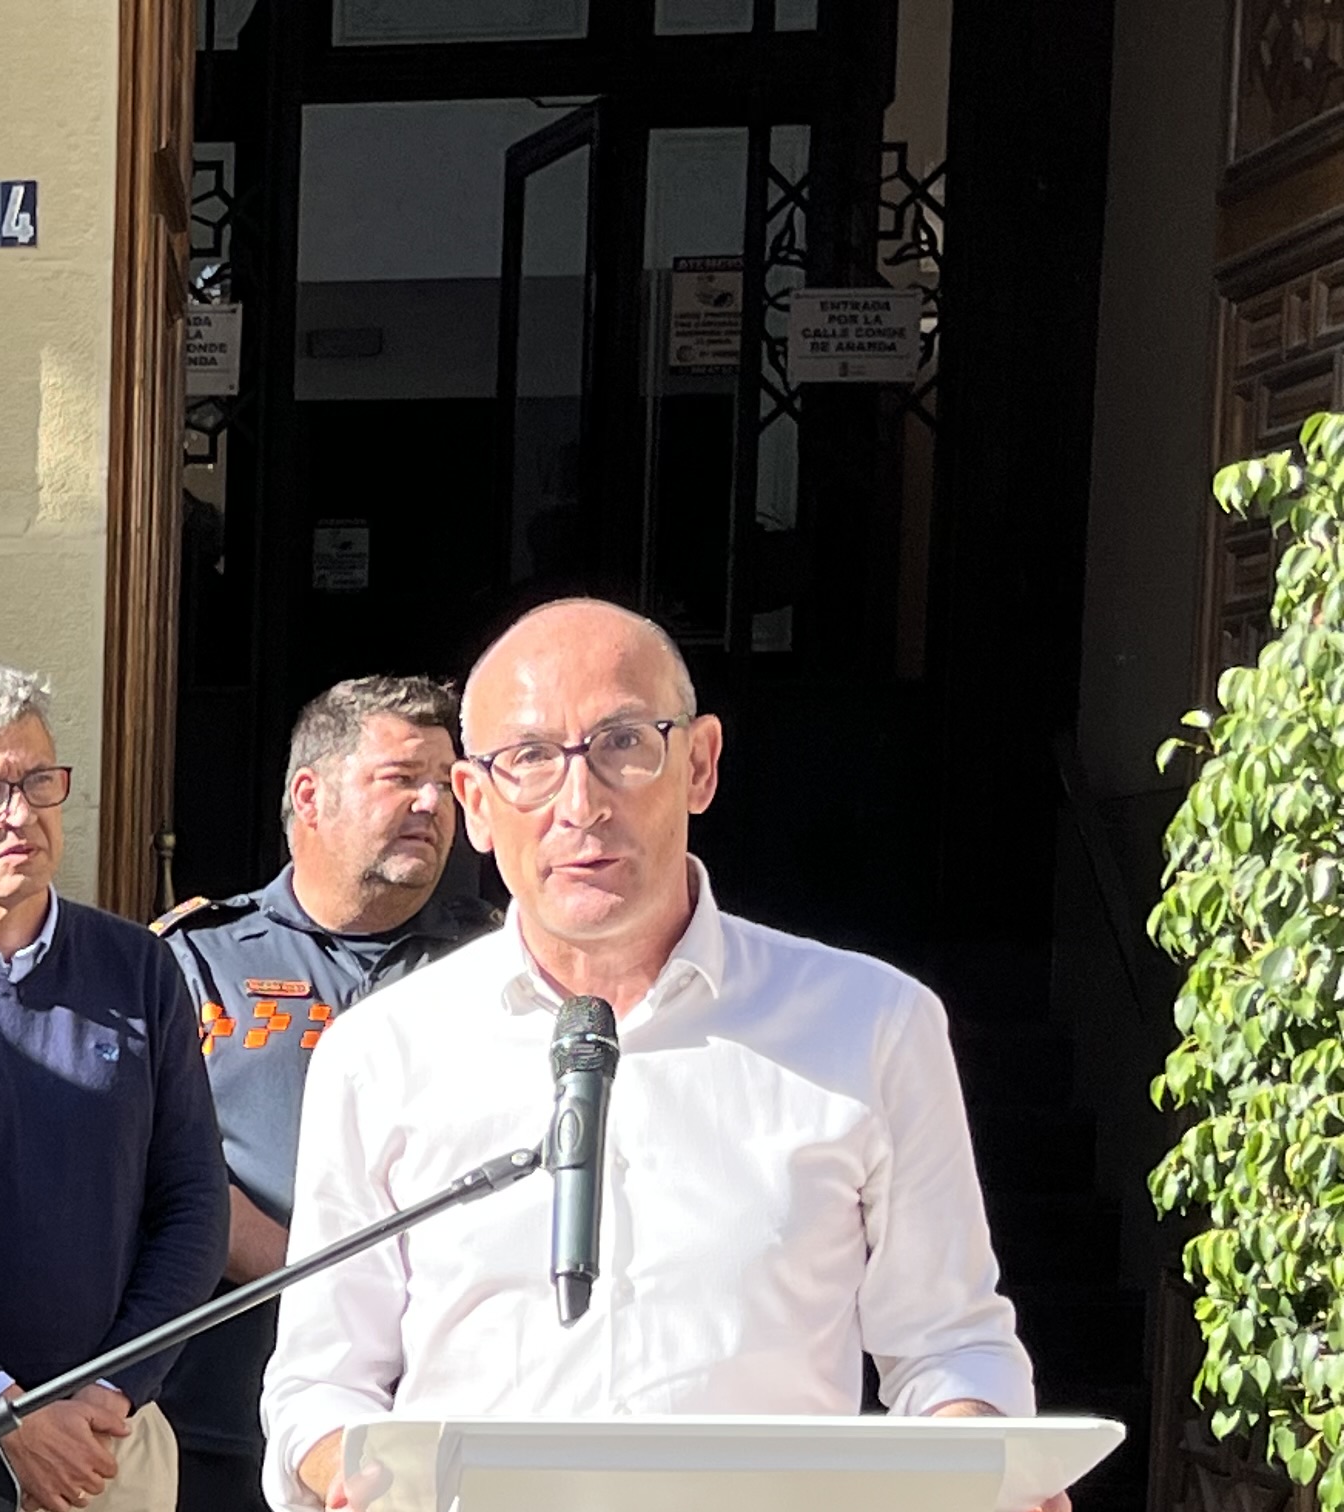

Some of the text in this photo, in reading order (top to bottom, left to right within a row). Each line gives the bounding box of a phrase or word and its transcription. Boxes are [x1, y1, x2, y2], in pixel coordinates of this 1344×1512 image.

[820, 301, 891, 312] ENTRADA
[828, 314, 883, 325] POR LA
[801, 327, 850, 339] CALLE
[186, 343, 227, 354] ONDE
[809, 341, 897, 352] DE ARANDA
